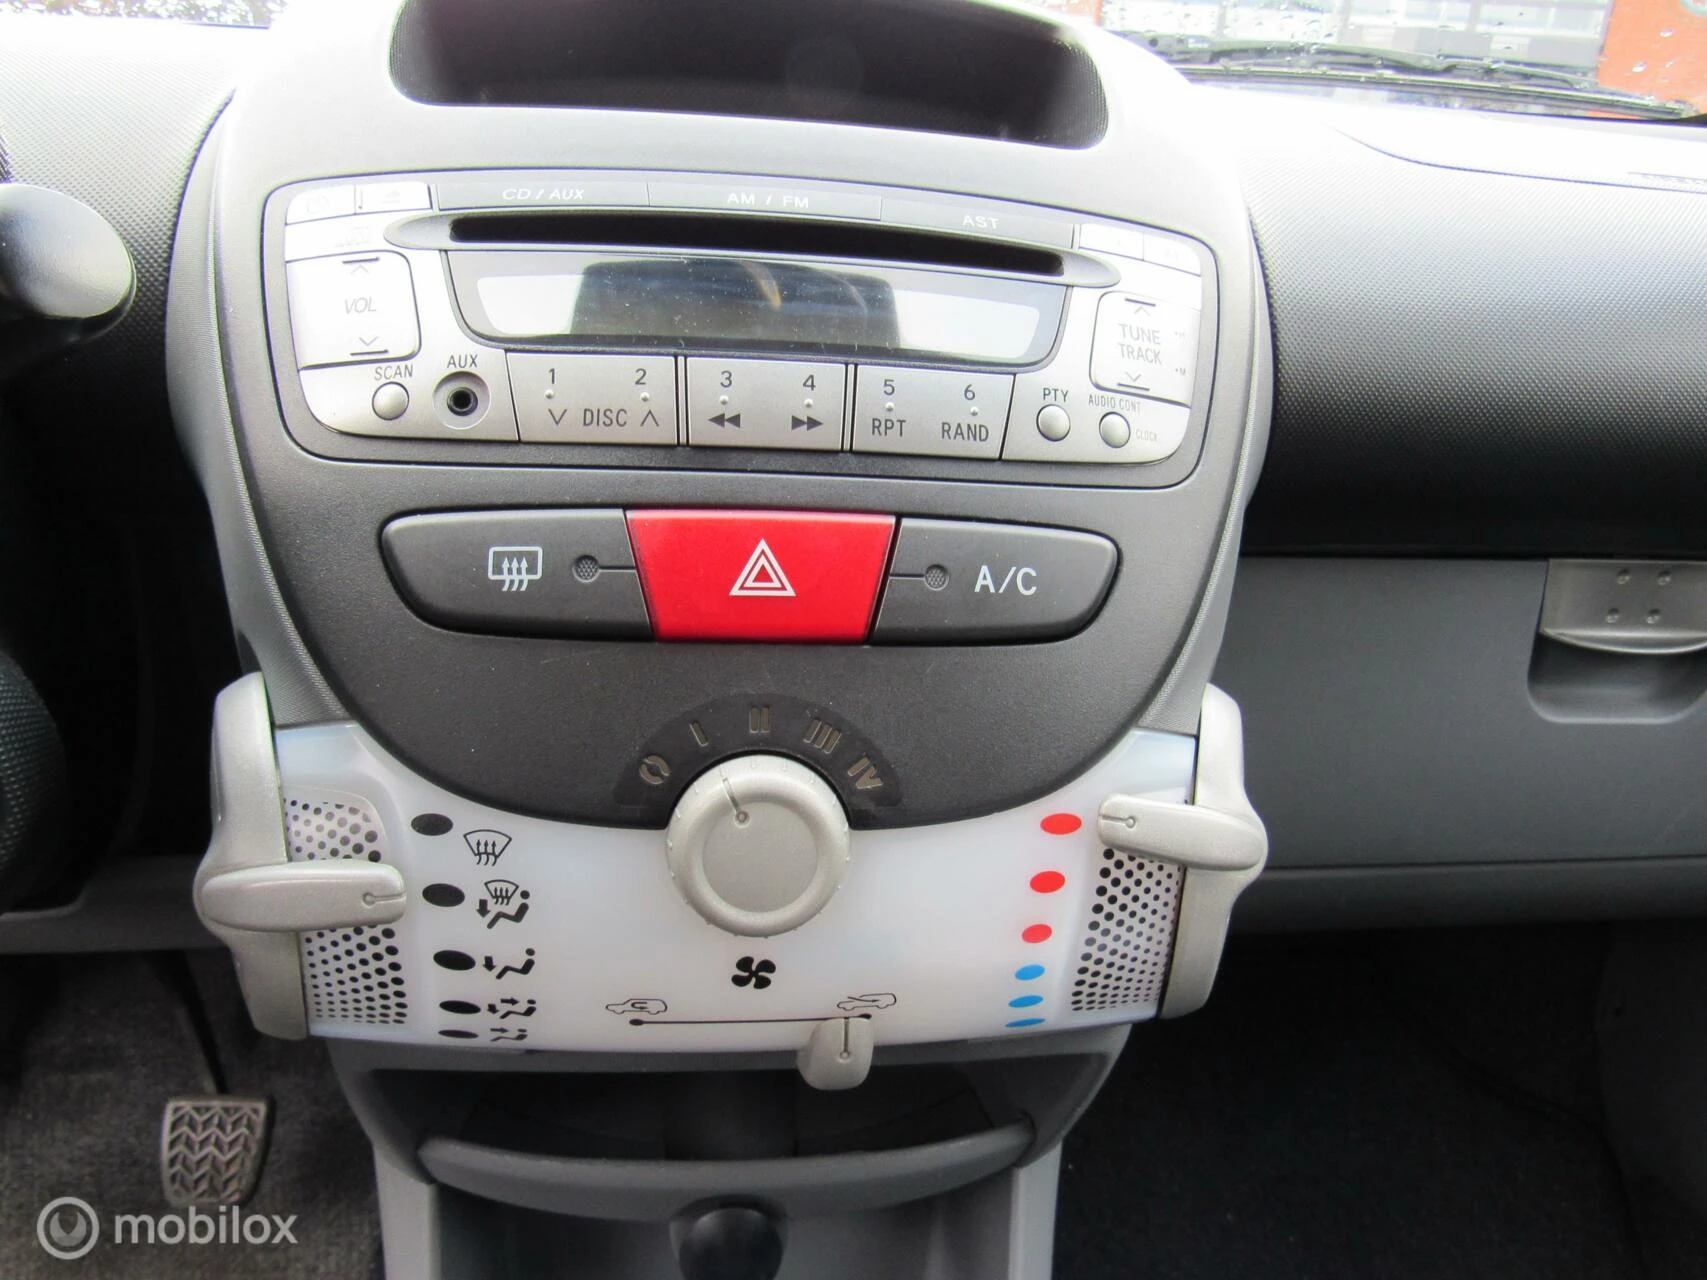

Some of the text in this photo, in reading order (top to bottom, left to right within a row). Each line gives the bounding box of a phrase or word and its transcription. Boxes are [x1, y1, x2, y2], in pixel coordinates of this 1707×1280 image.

[502, 188, 531, 200] CD
[549, 188, 585, 200] AUX
[726, 192, 756, 205] AM
[782, 195, 809, 208] FM
[963, 214, 999, 229] AST
[344, 297, 377, 314] VOL
[1118, 323, 1161, 345] TUNE
[447, 354, 479, 369] AUX
[1118, 343, 1163, 366] TRACK
[374, 364, 414, 381] SCAN
[549, 368, 556, 385] 1
[635, 368, 647, 385] 2
[720, 371, 733, 388] 3
[802, 374, 816, 391] 4
[883, 379, 895, 396] 5
[964, 384, 976, 400] 6
[1043, 387, 1069, 401] PTY
[1088, 393, 1142, 414] AUDIO CONT
[583, 408, 628, 428] DISC
[871, 418, 907, 437] RPT
[941, 422, 989, 442] RAND
[1135, 428, 1158, 442] CLOCK
[974, 564, 1037, 596] A/C
